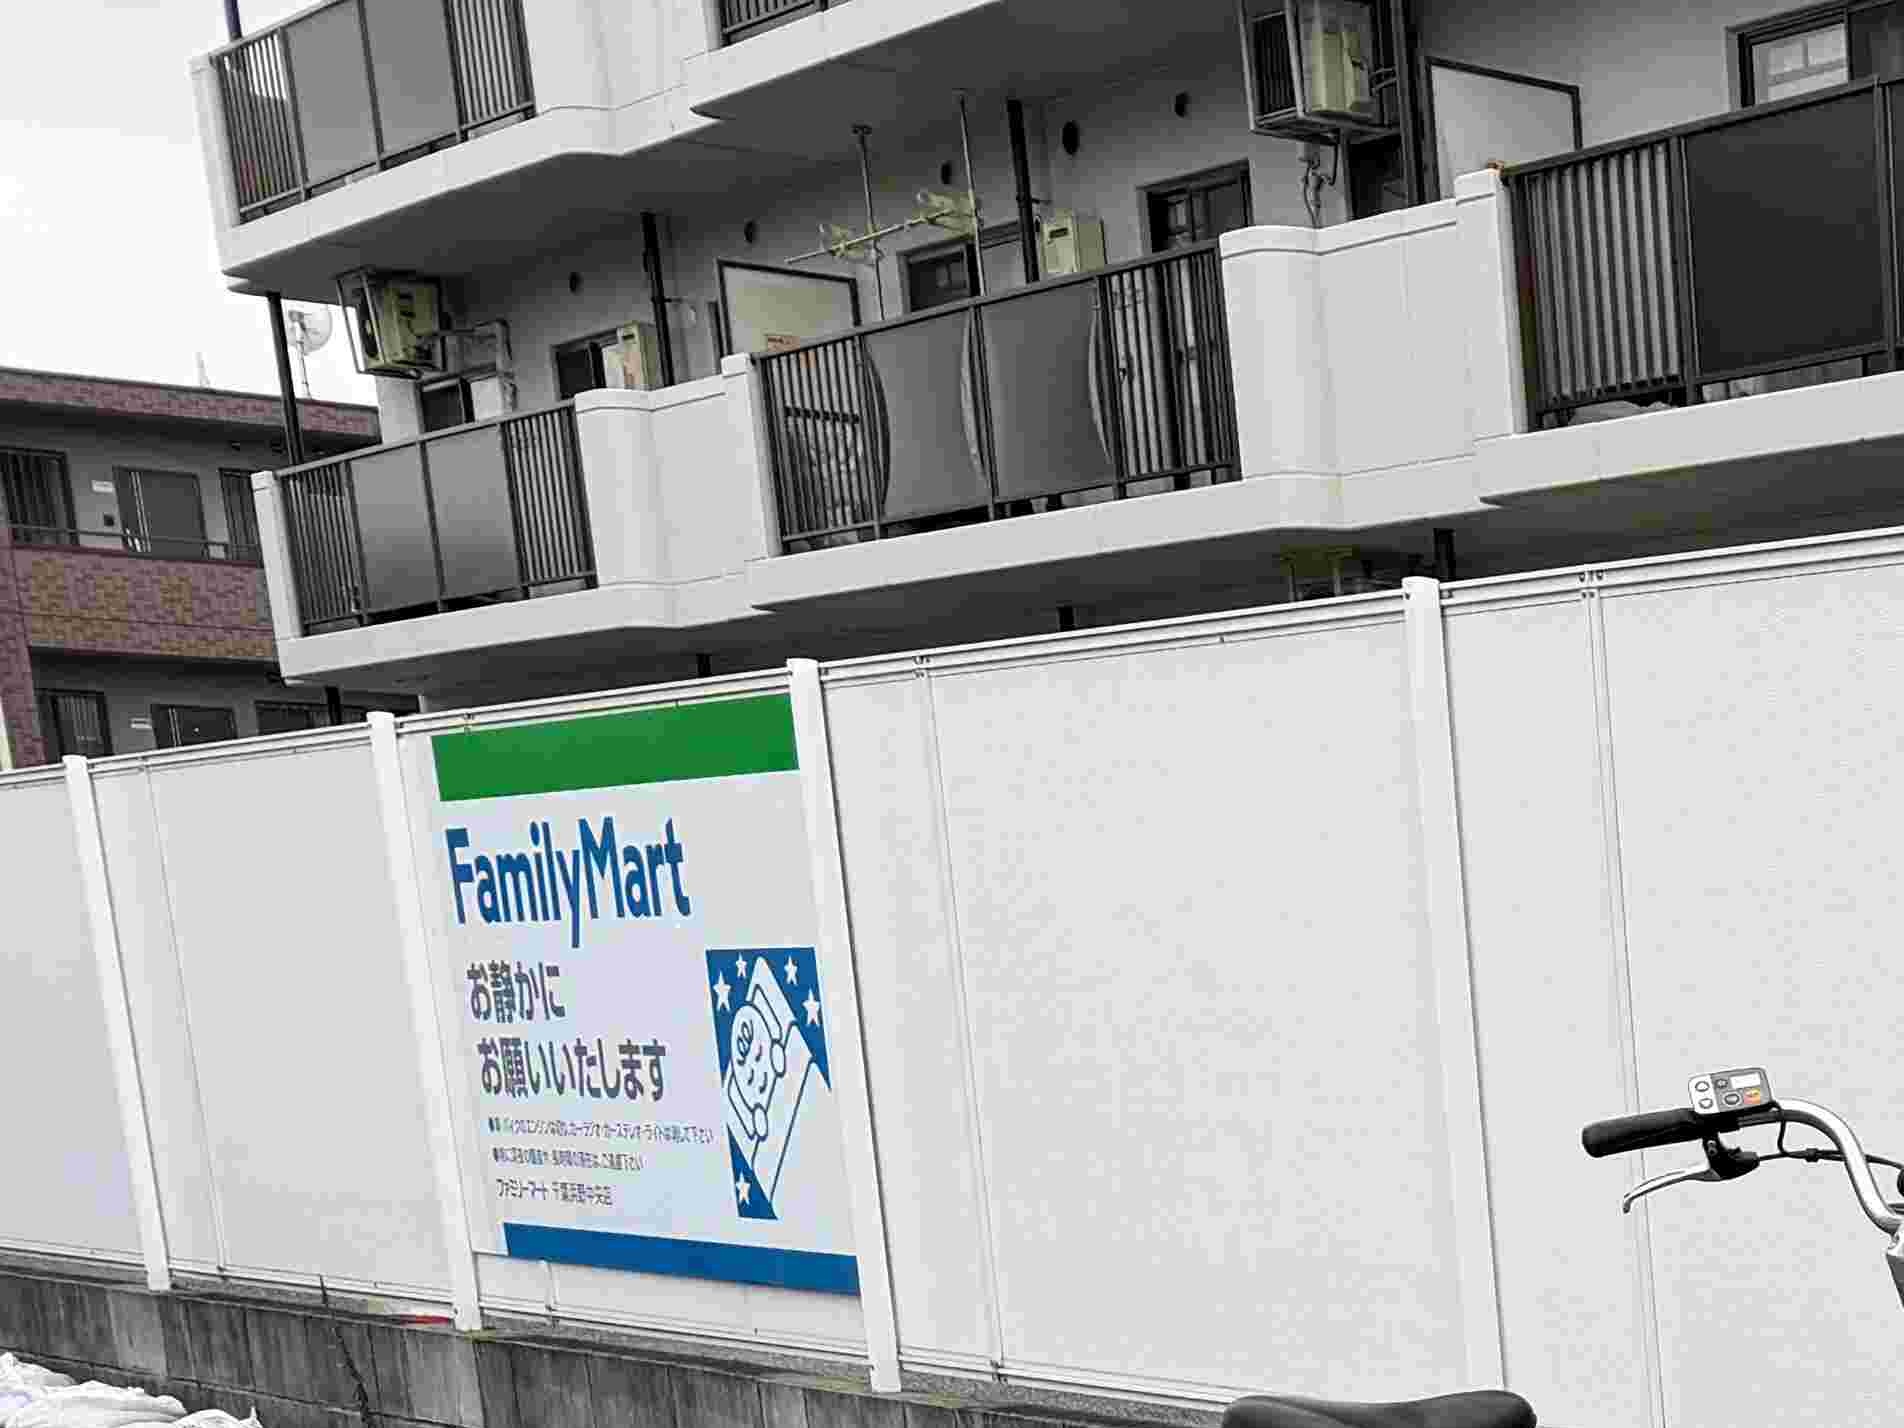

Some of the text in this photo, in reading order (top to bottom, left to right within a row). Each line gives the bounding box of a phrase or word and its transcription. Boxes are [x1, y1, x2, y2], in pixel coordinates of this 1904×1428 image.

[445, 816, 691, 948] FamilyMart
[466, 960, 566, 1023] お静かに
[477, 1037, 666, 1101] お願いいたします
